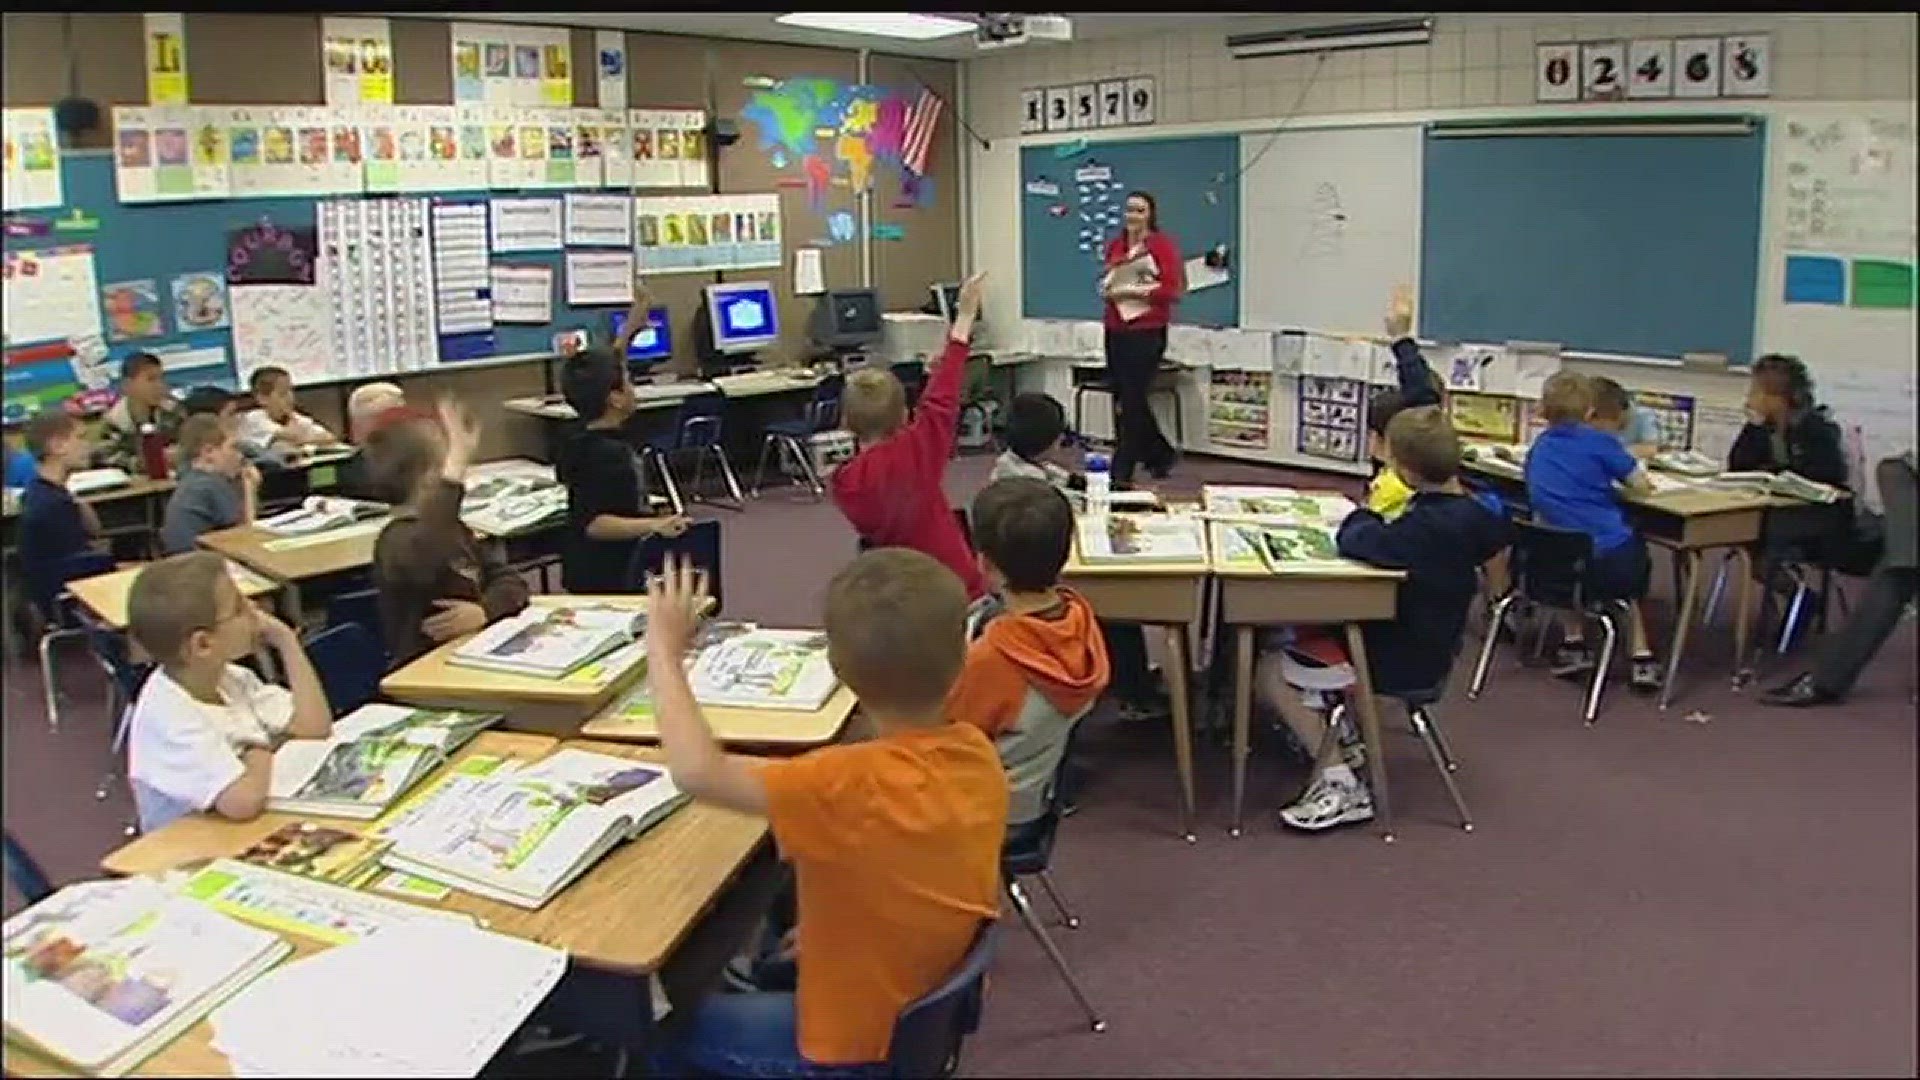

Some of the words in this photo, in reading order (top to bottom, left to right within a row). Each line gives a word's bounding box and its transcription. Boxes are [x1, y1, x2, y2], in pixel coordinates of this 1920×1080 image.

[1546, 57, 1570, 86] 0
[1592, 57, 1618, 84] 2
[1637, 54, 1662, 82] 4
[1685, 52, 1711, 82] 6
[1735, 48, 1758, 80] 8
[1027, 101, 1037, 120] 1
[1053, 97, 1065, 120] 3
[1079, 95, 1091, 116] 5
[1105, 92, 1119, 115] 7
[1132, 88, 1149, 112] 9
